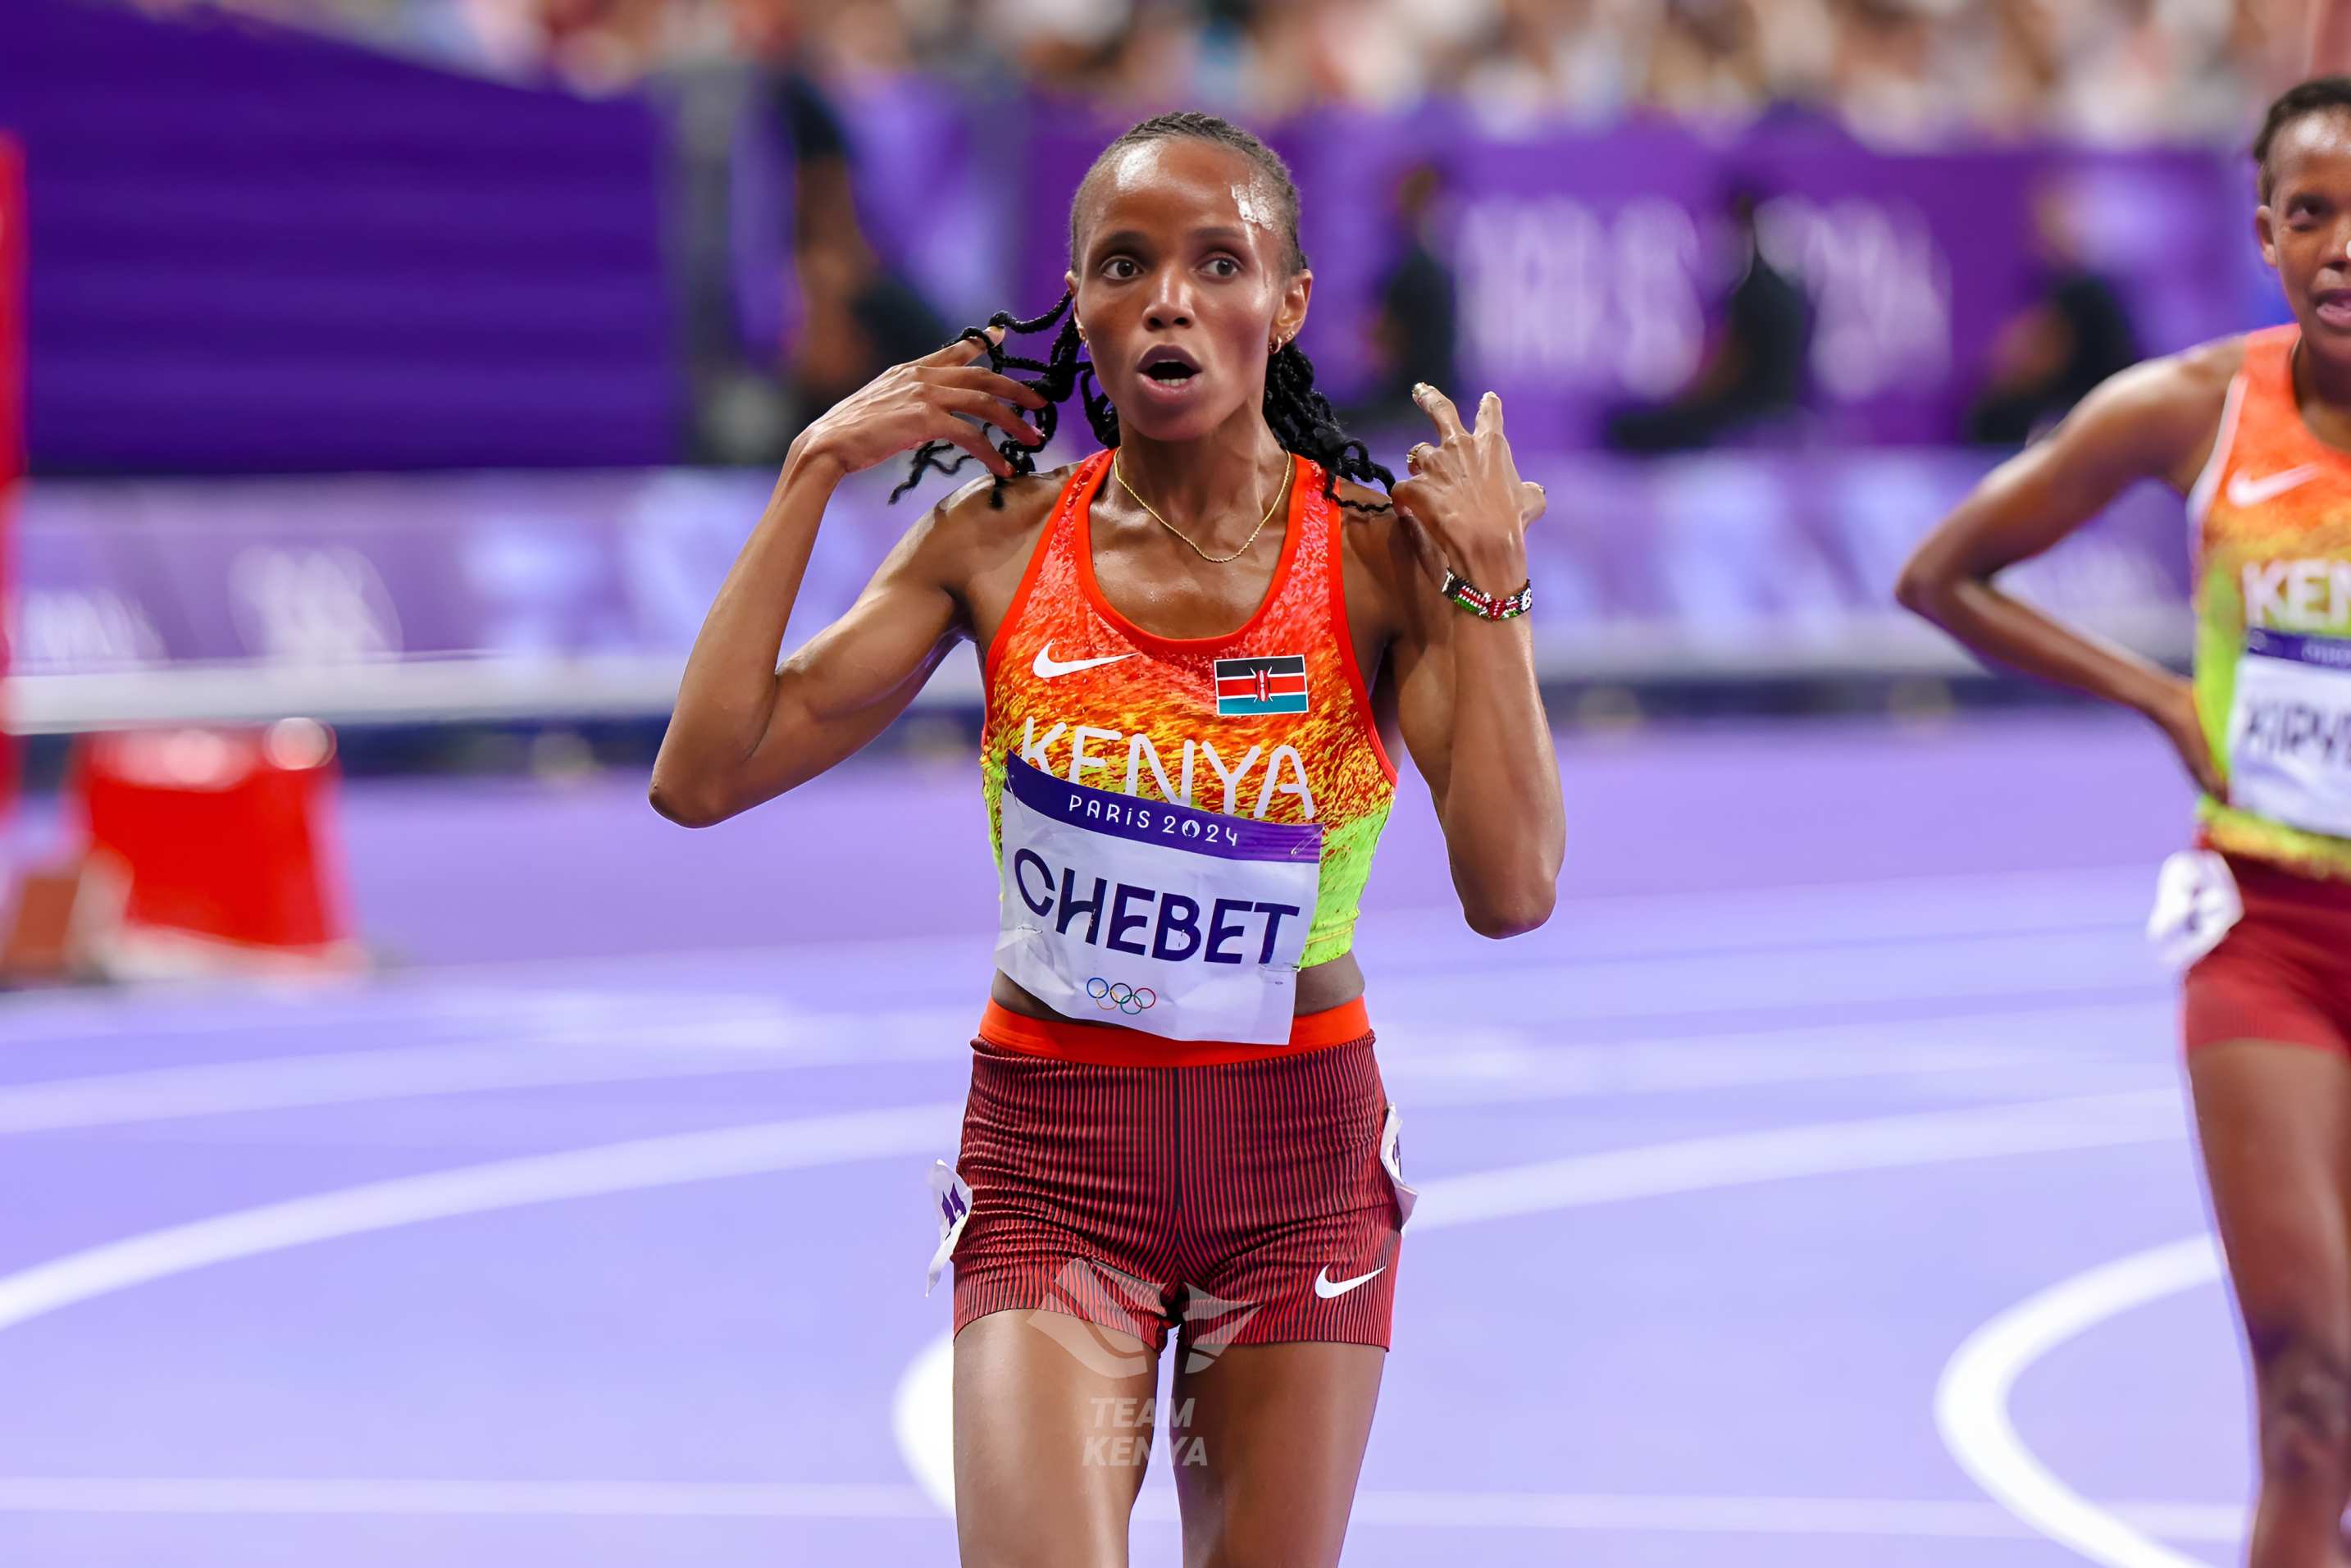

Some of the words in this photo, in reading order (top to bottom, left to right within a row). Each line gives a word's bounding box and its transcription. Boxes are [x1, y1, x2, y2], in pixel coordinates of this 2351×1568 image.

[1022, 716, 1315, 819] KENYA
[1162, 816, 1238, 846] 2024
[1014, 848, 1300, 964] CHEBET
